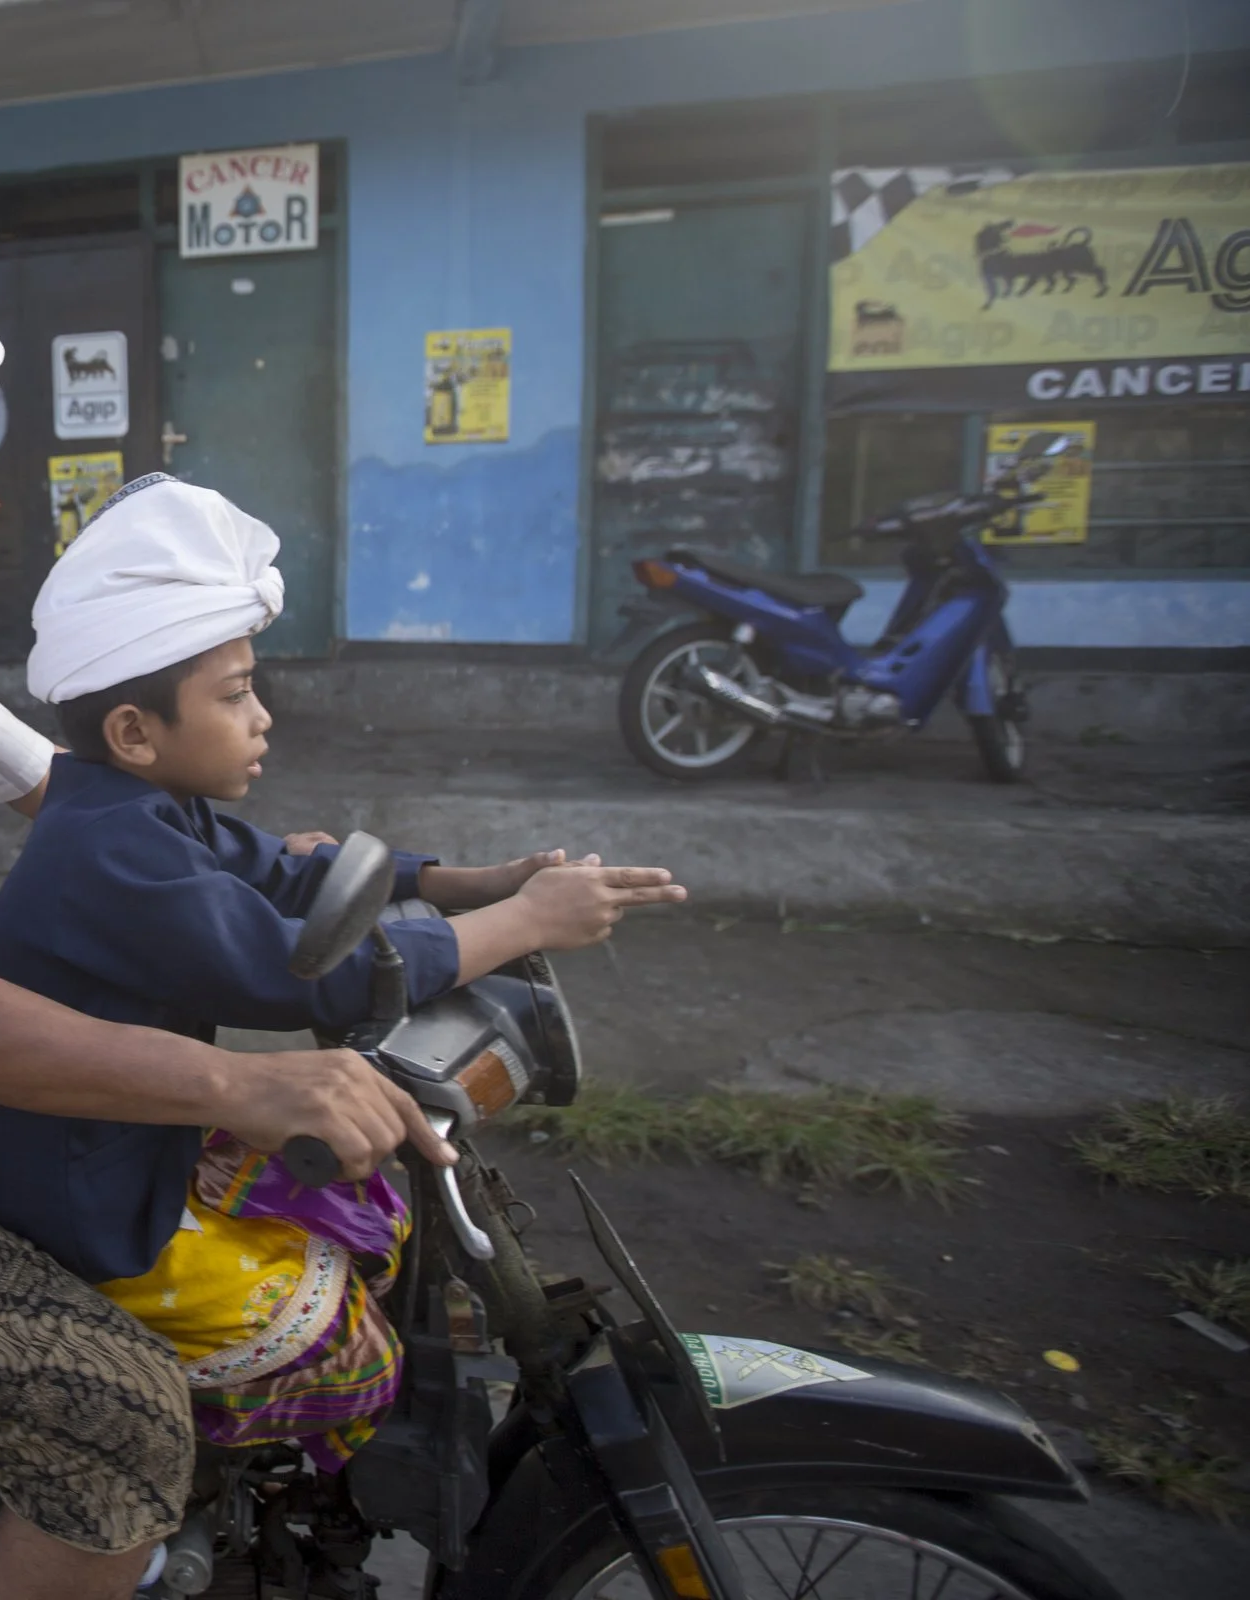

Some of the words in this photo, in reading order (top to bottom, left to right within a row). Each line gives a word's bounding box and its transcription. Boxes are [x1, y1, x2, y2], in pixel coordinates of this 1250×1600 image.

[186, 155, 310, 194] CANCER
[187, 194, 308, 249] MOTOR
[67, 398, 117, 424] Agip
[690, 1352, 719, 1398] YUDHA
